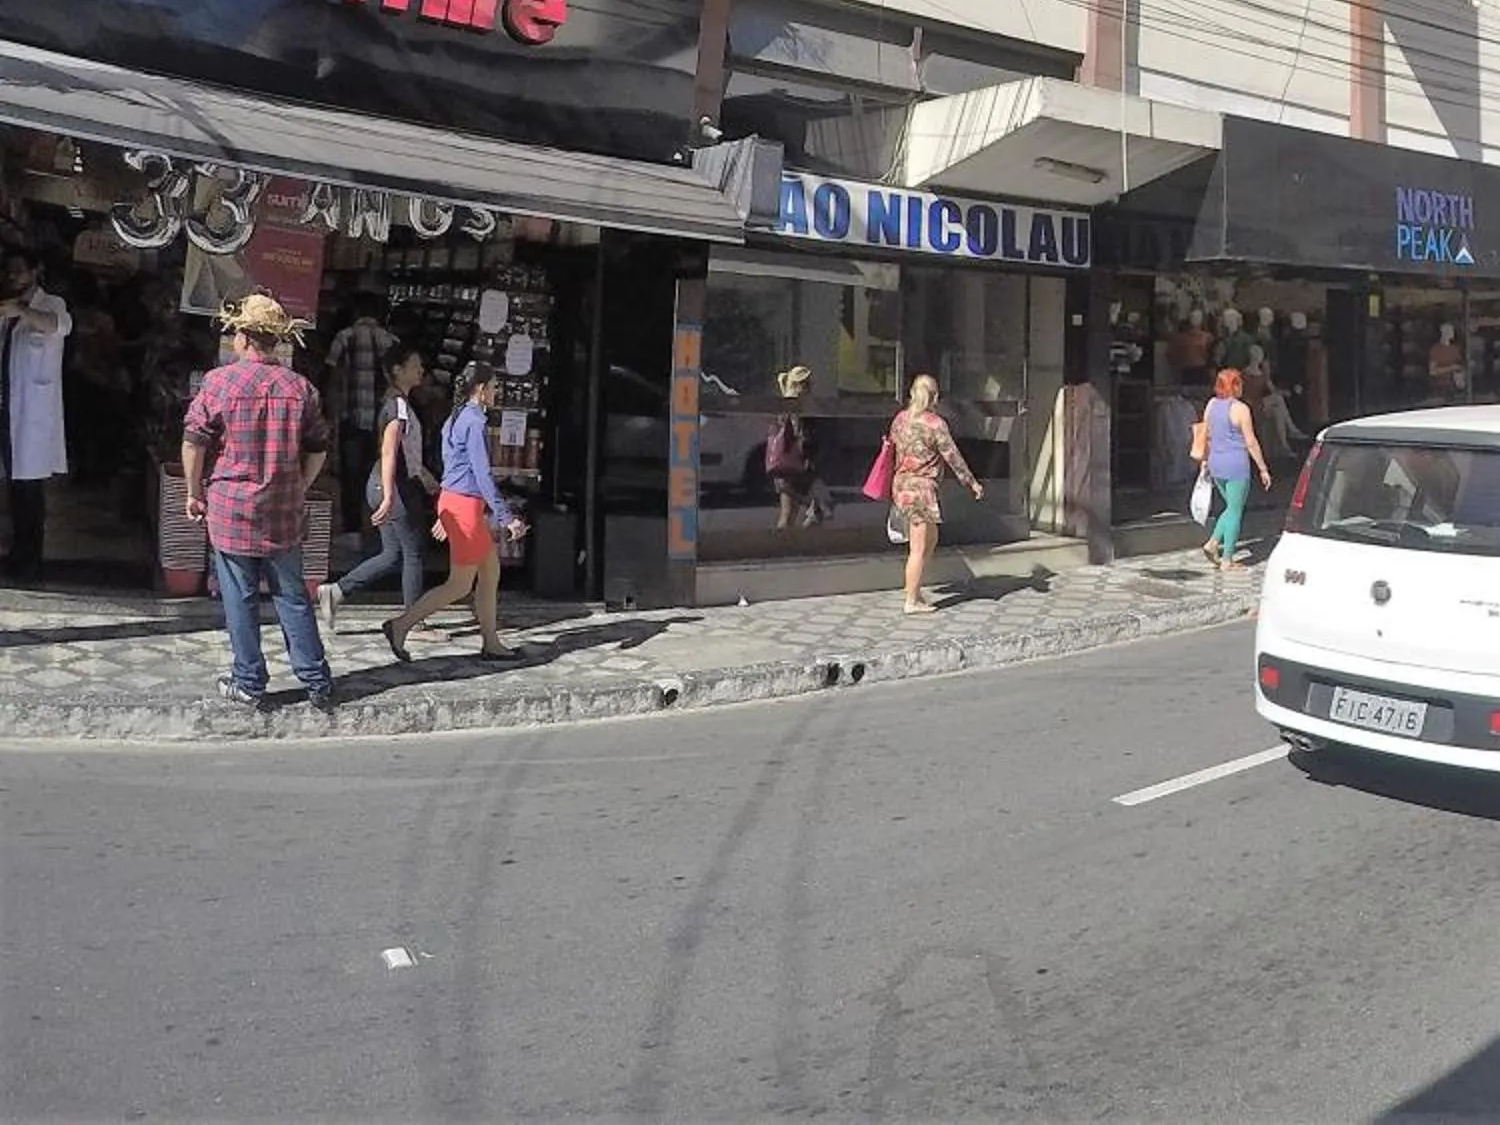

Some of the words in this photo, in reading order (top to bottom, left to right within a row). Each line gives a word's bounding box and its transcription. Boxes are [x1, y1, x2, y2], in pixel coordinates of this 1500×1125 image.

[867, 189, 1090, 265] NICOLAU
[1396, 186, 1474, 230] NORTH
[1397, 223, 1454, 263] PEAK
